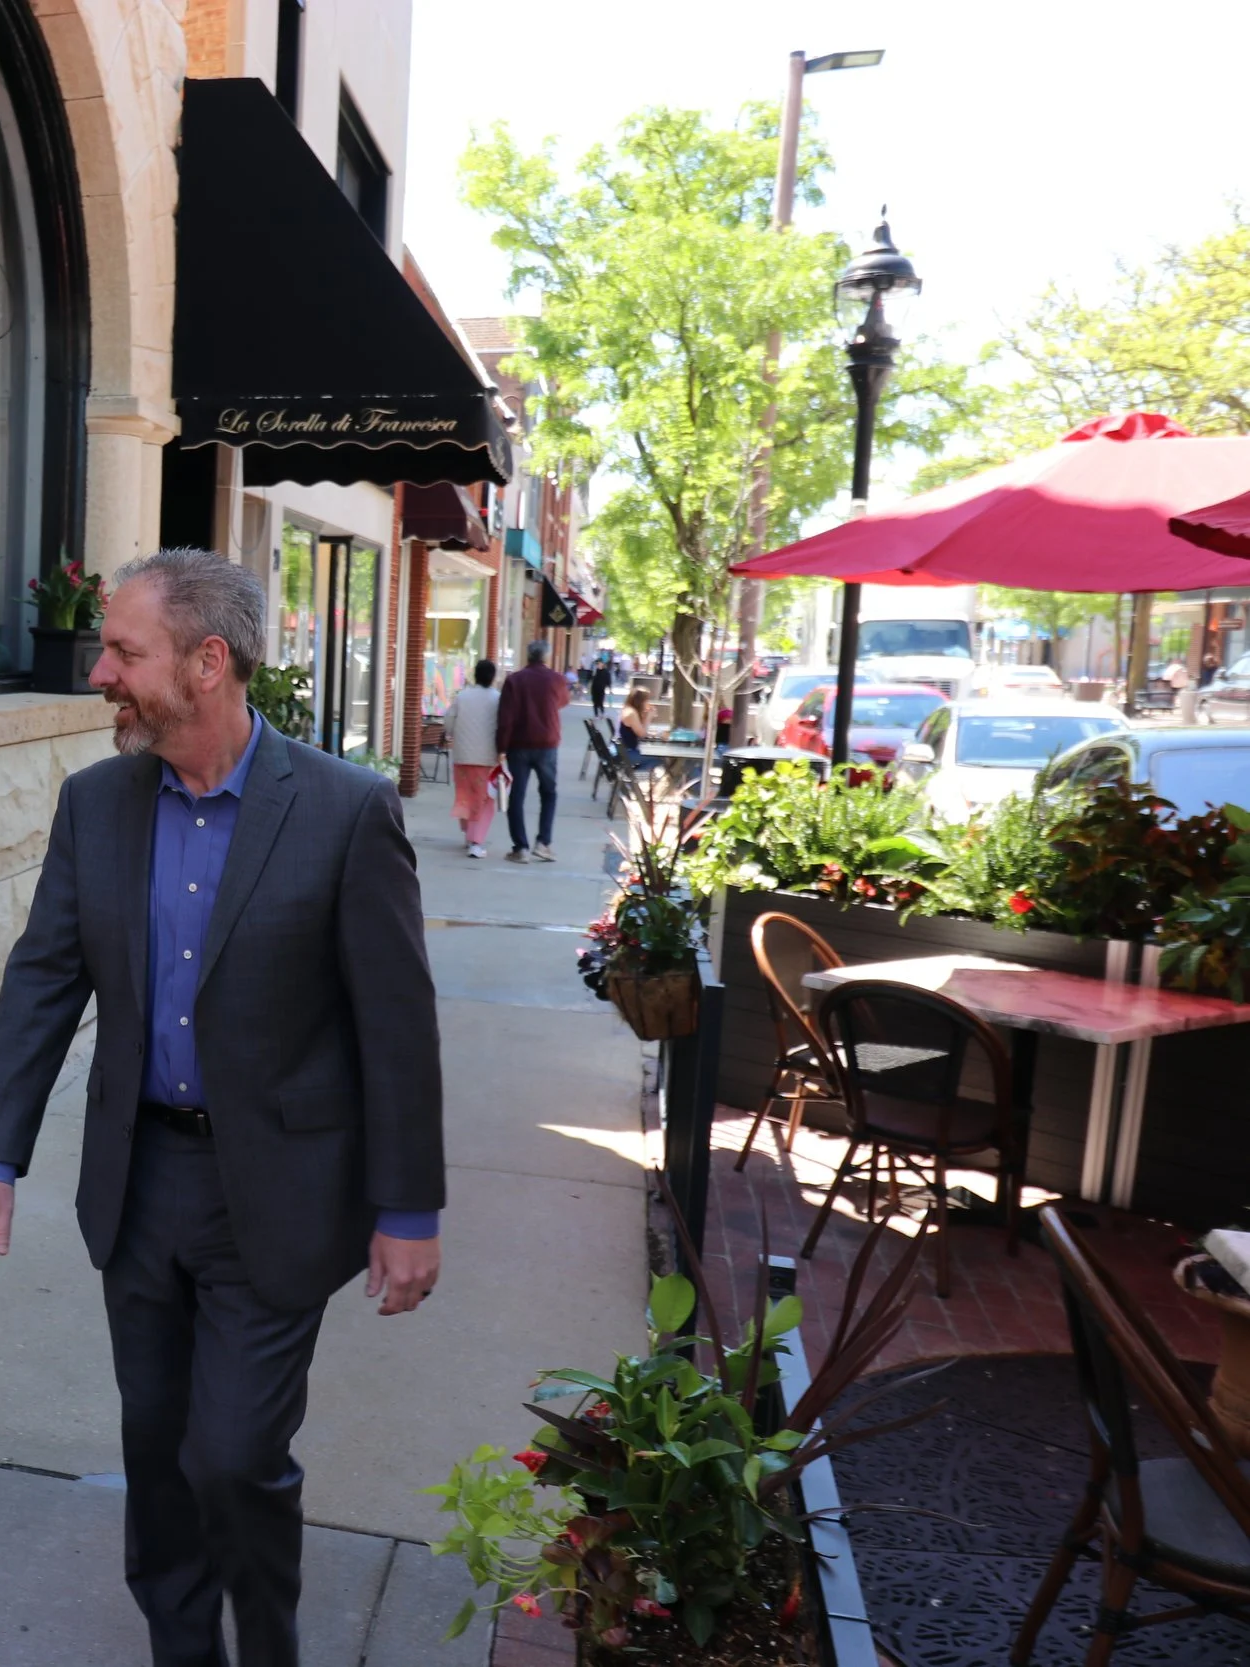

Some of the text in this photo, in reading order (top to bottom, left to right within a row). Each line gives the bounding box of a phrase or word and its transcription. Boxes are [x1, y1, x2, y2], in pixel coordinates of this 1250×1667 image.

[215, 407, 458, 434] La Sorella di Francesca
